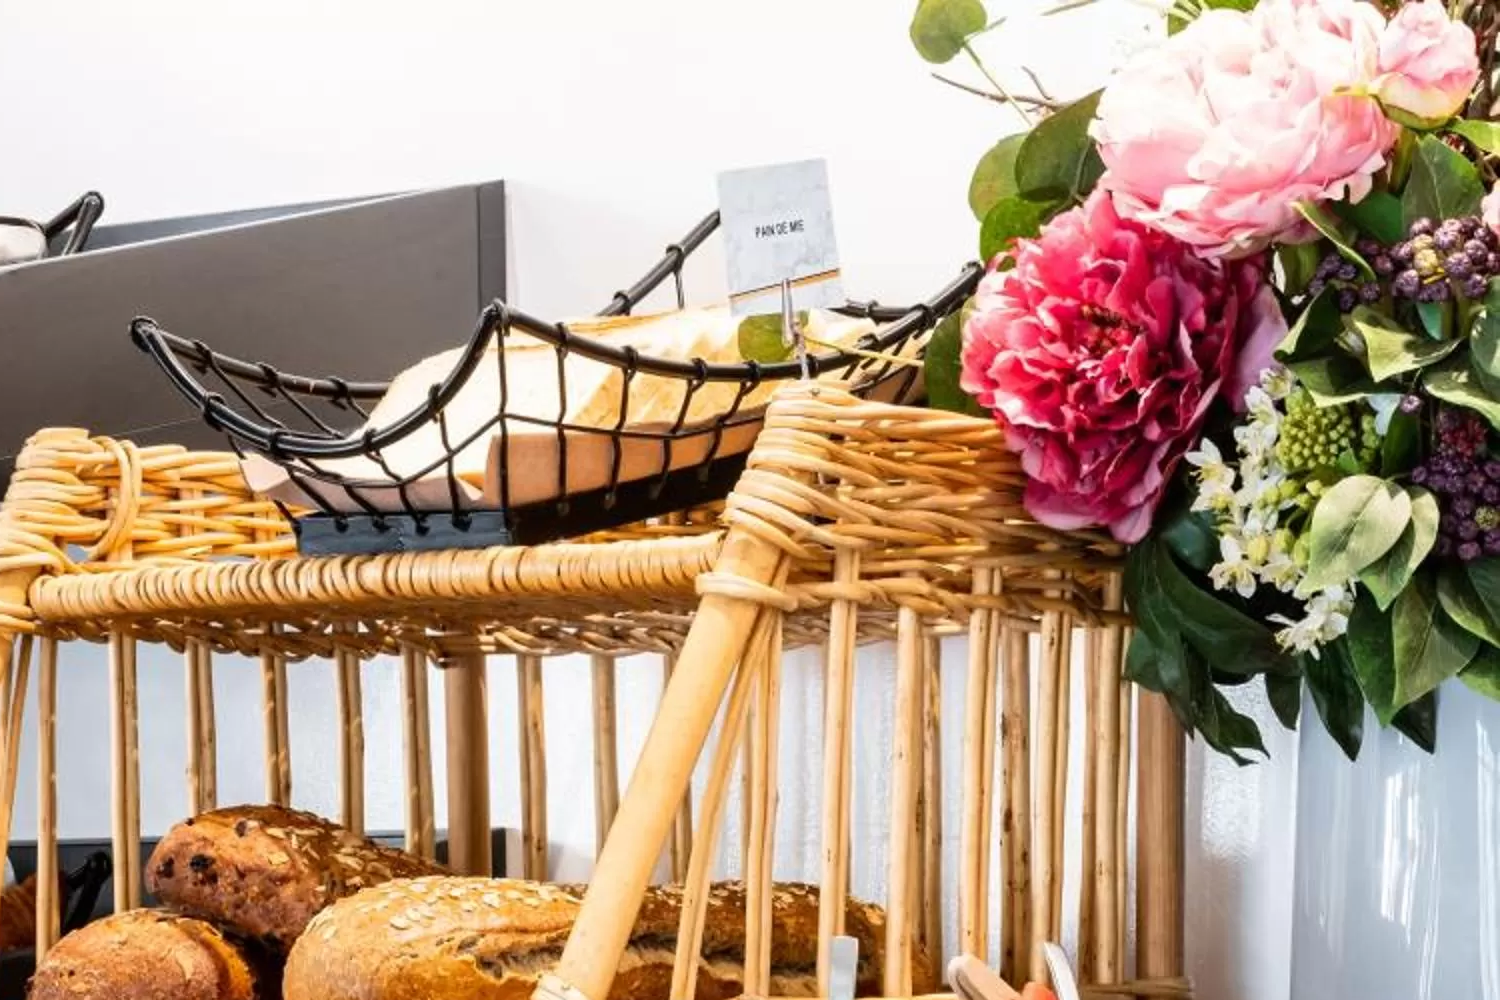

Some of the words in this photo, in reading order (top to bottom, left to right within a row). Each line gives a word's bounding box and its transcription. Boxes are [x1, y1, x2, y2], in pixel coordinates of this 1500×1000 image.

[755, 225, 775, 239] PAIN
[775, 221, 789, 235] DE
[789, 219, 805, 233] MIE
